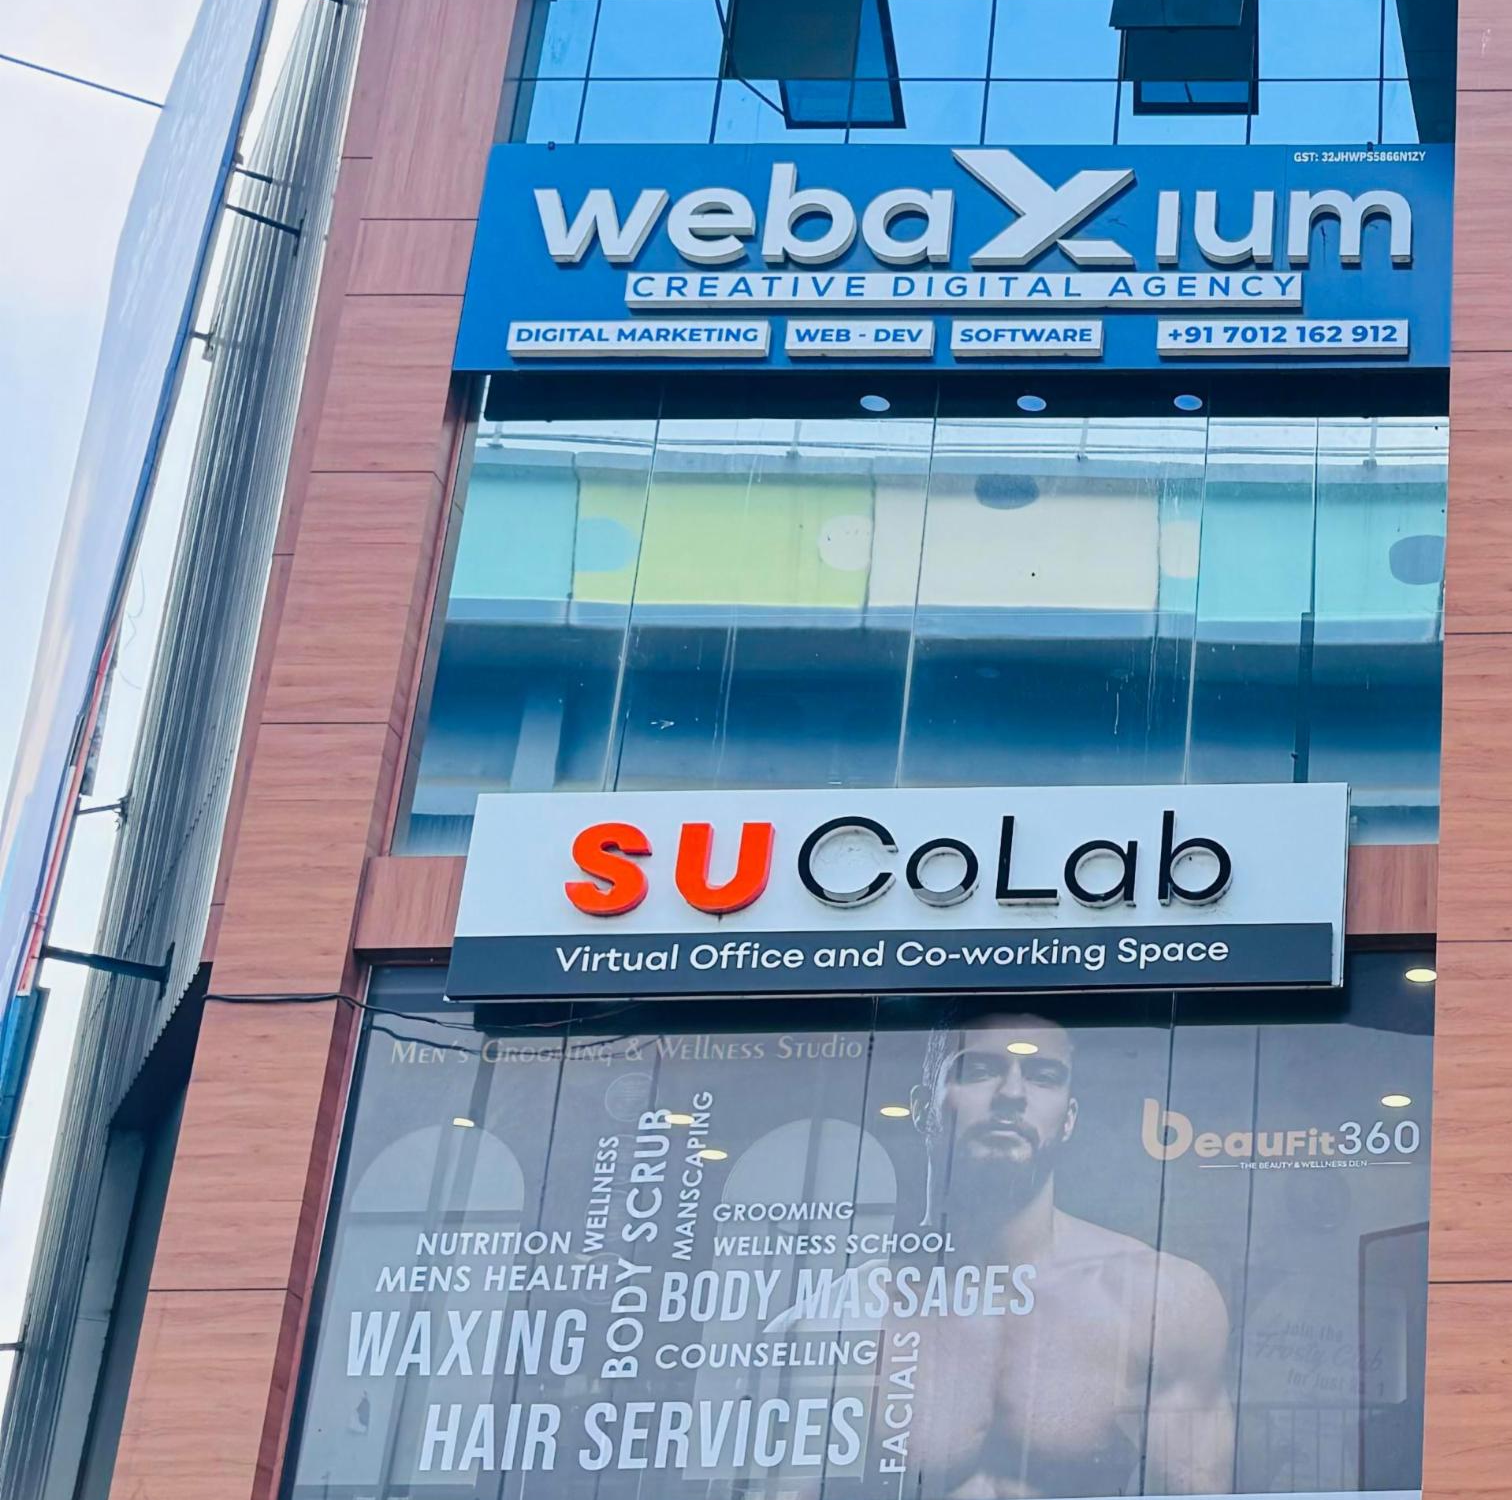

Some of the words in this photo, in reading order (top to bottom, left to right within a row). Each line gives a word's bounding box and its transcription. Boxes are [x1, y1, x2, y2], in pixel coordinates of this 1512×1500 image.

[1294, 152, 1319, 162] GST:
[632, 274, 866, 299] CREATIVE
[892, 274, 1084, 299] DIGITAL
[1107, 274, 1297, 299] AGENCY
[514, 326, 609, 345] DIGITAL
[616, 326, 760, 345] MARKETING
[794, 326, 849, 344] WEB
[873, 326, 924, 344] DEV
[959, 325, 1093, 344] SOFTWARE
[1167, 325, 1215, 345] +91
[1221, 325, 1283, 344] 7012
[1289, 325, 1343, 344] 162
[1349, 324, 1399, 344] 912
[555, 941, 680, 973] Virtual
[689, 941, 805, 970] Office
[814, 940, 885, 968] and
[897, 937, 1107, 975] Co-working
[1117, 935, 1230, 972] Space
[583, 1135, 620, 1253] WELLNESS
[622, 1107, 673, 1244] SCRUB
[672, 1090, 714, 1261] MANSCAPING
[713, 1201, 855, 1223] GROOMING
[416, 1231, 572, 1256] NUTRITION
[713, 1235, 837, 1257] WELLNESS
[845, 1232, 956, 1255] SCHOOL
[375, 1264, 472, 1293] MENS
[483, 1263, 609, 1292] HEALTH
[658, 1268, 782, 1323] BODY
[794, 1263, 1037, 1320] MASSAGES
[601, 1257, 652, 1380] BODY
[346, 1307, 587, 1377] WAXING
[654, 1339, 878, 1371] COUNSELLING
[879, 1330, 921, 1475] FACIALS
[418, 1402, 562, 1472] HAIR
[578, 1396, 865, 1471] SERVICES
